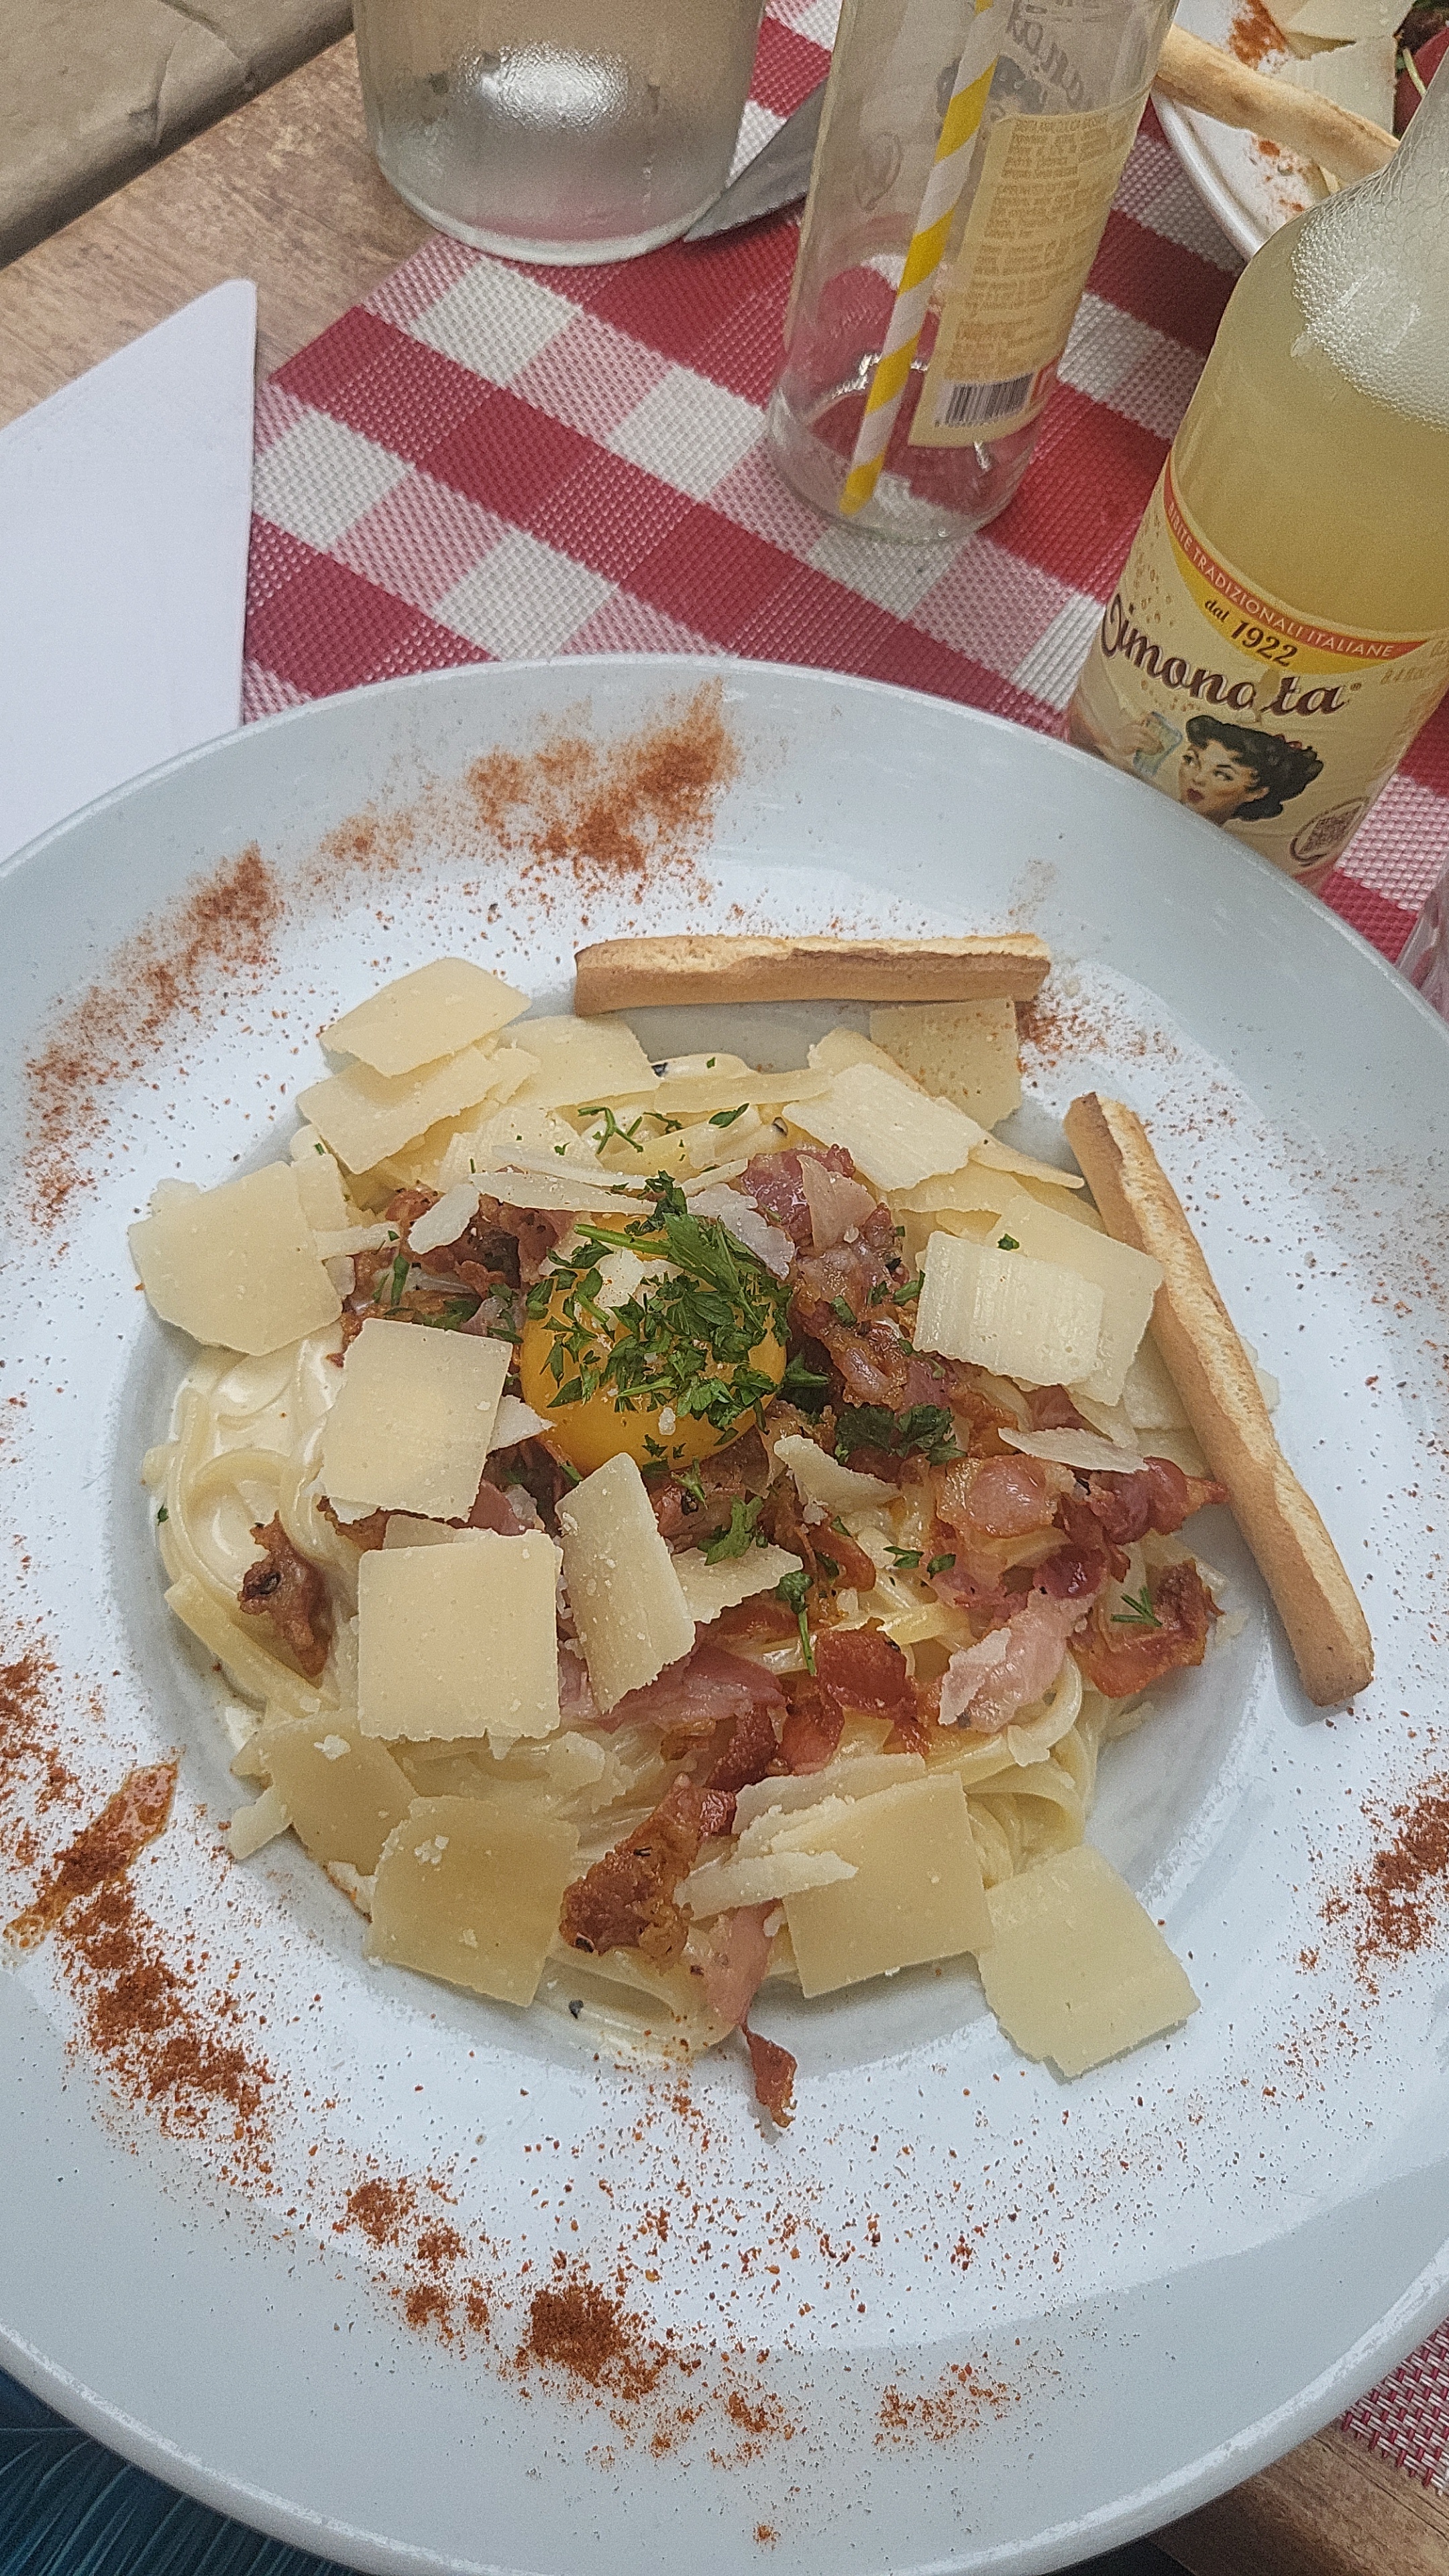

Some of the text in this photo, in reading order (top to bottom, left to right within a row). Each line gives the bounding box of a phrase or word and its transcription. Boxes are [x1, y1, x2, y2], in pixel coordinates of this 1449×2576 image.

[1168, 502, 1193, 551] BIBITE
[1193, 547, 1303, 638] TRADIZIONALI
[1307, 629, 1394, 657] ITALIANE
[1204, 599, 1298, 667] dal 1922
